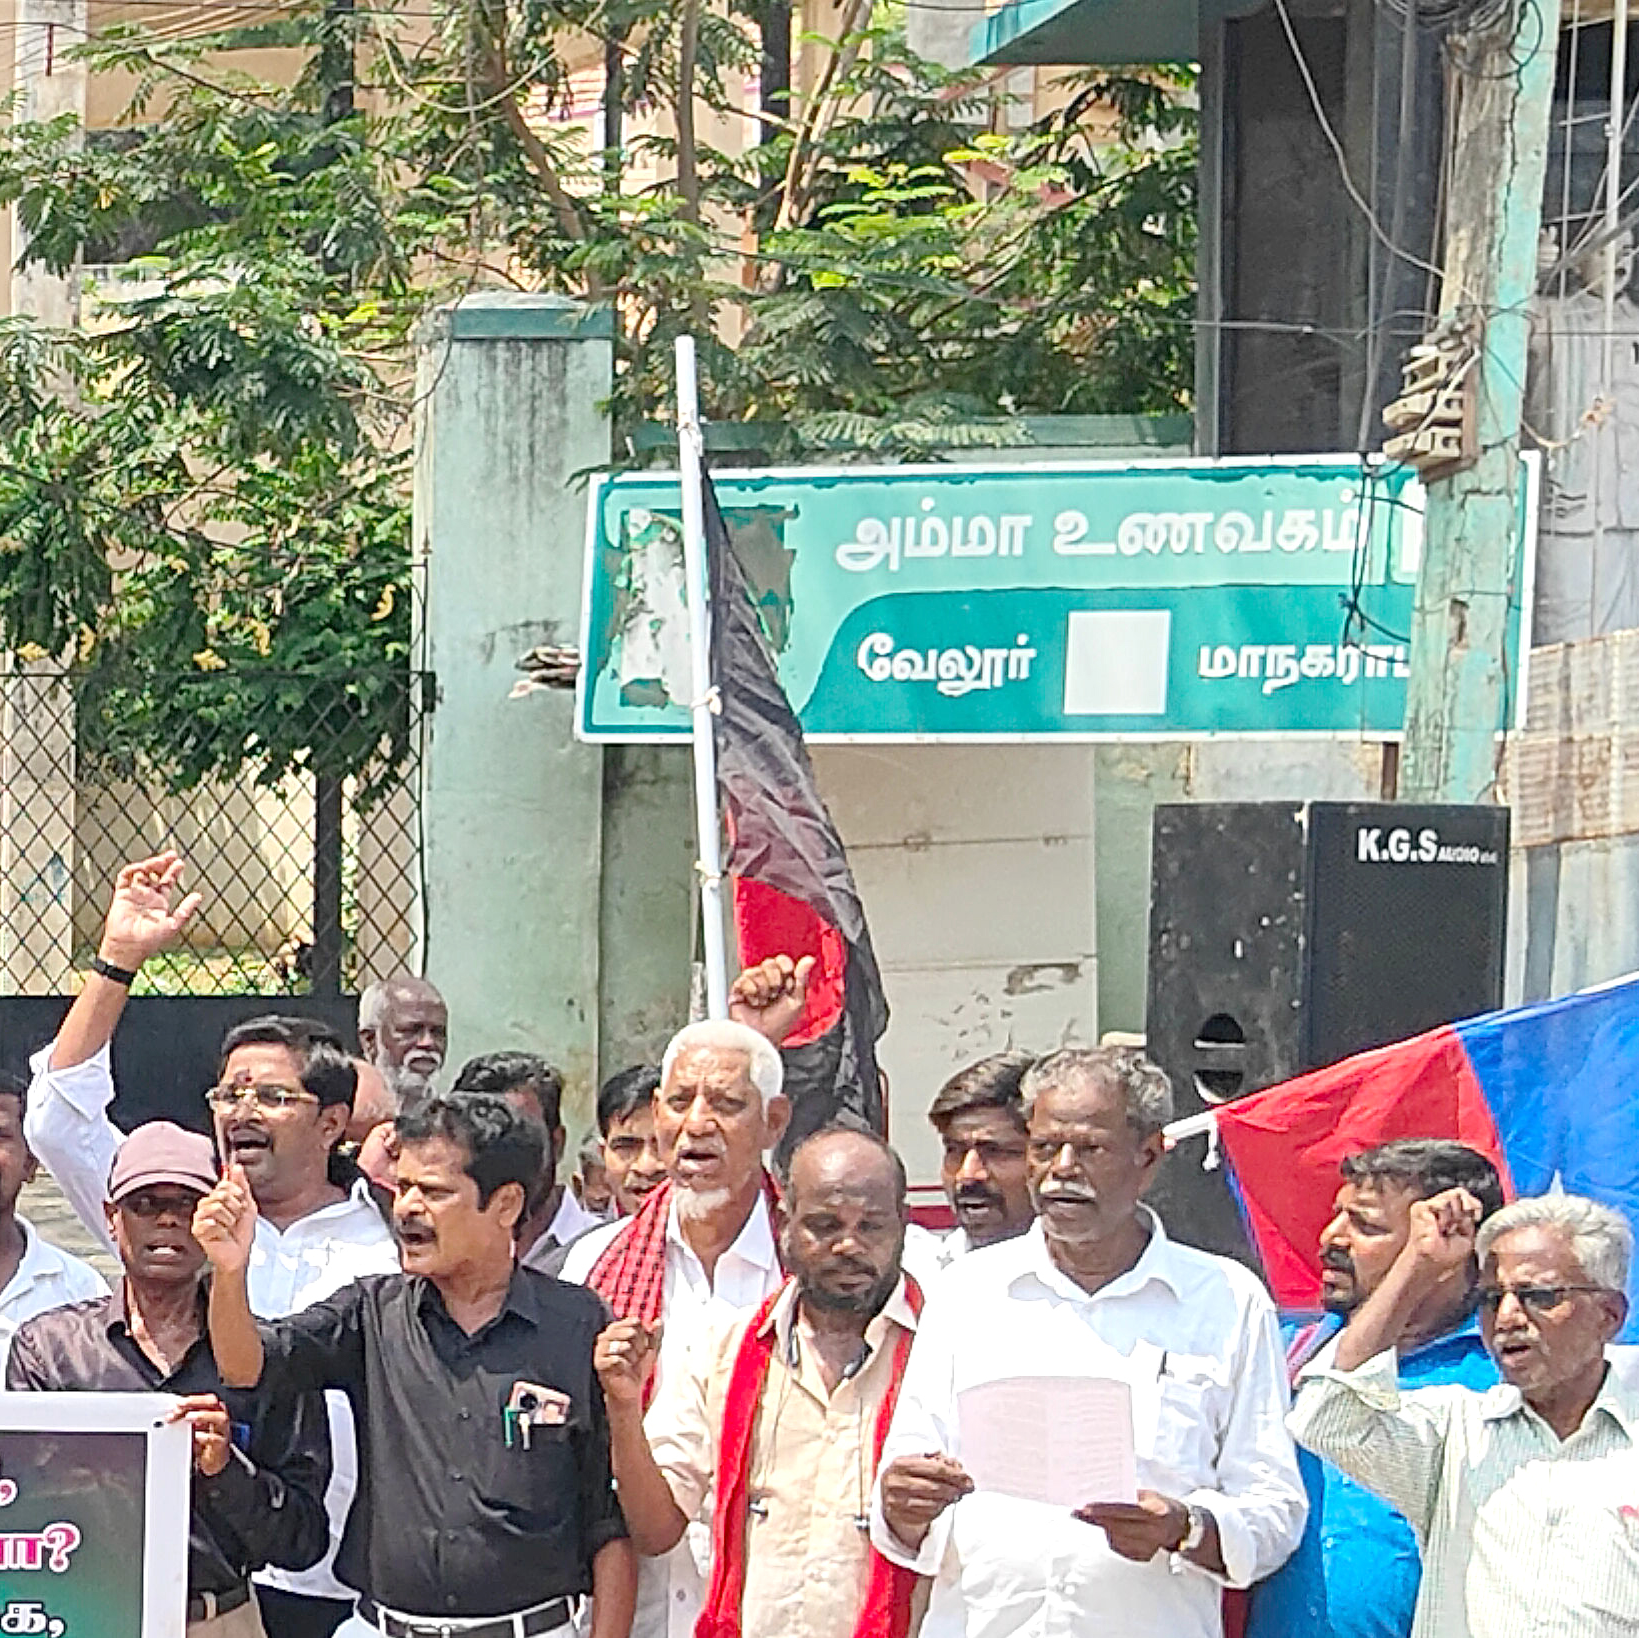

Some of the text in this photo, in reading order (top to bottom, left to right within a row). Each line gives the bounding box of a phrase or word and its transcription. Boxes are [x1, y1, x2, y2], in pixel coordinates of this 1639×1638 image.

[836, 487, 1370, 571] அம்மா உணவகம்
[857, 632, 1036, 699] வேலூர்
[1357, 828, 1438, 863] K.G.S
